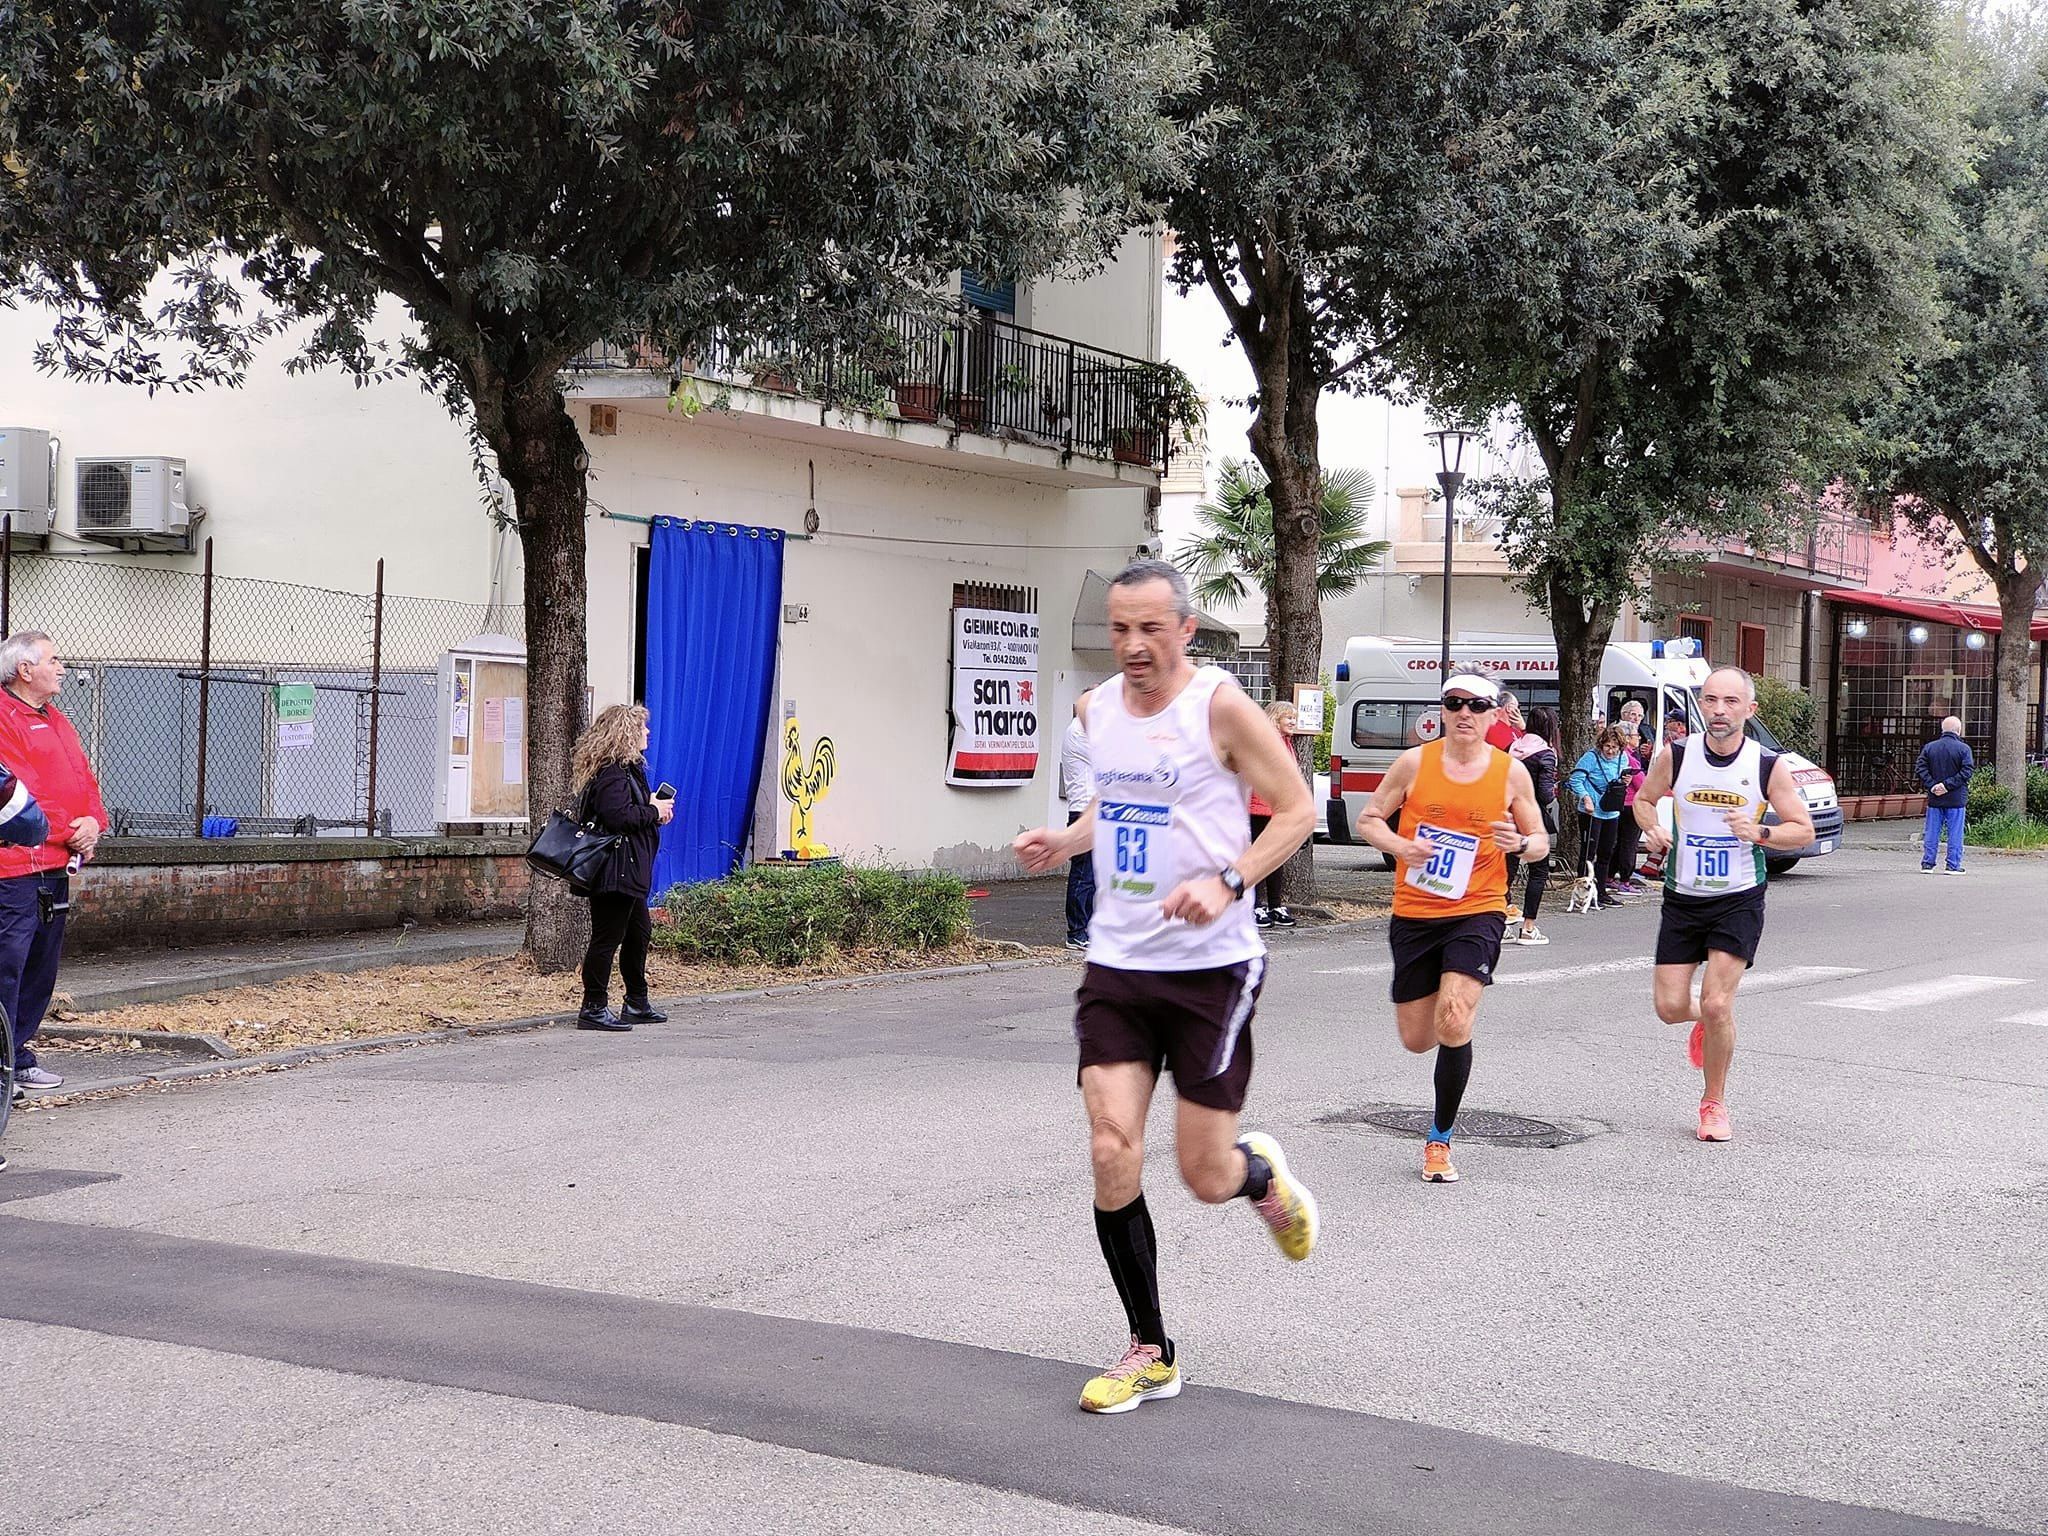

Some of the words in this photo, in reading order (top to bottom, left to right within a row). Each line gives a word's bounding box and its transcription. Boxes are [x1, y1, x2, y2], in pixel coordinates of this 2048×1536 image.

[281, 698, 313, 707] DEPOSITO
[973, 678, 1011, 706] san
[286, 709, 307, 717] BORSE
[974, 708, 1037, 737] marco
[1692, 792, 1740, 806] MAMELI
[1117, 826, 1147, 874] 63
[1426, 845, 1456, 879] 59
[1695, 849, 1729, 877] 150
